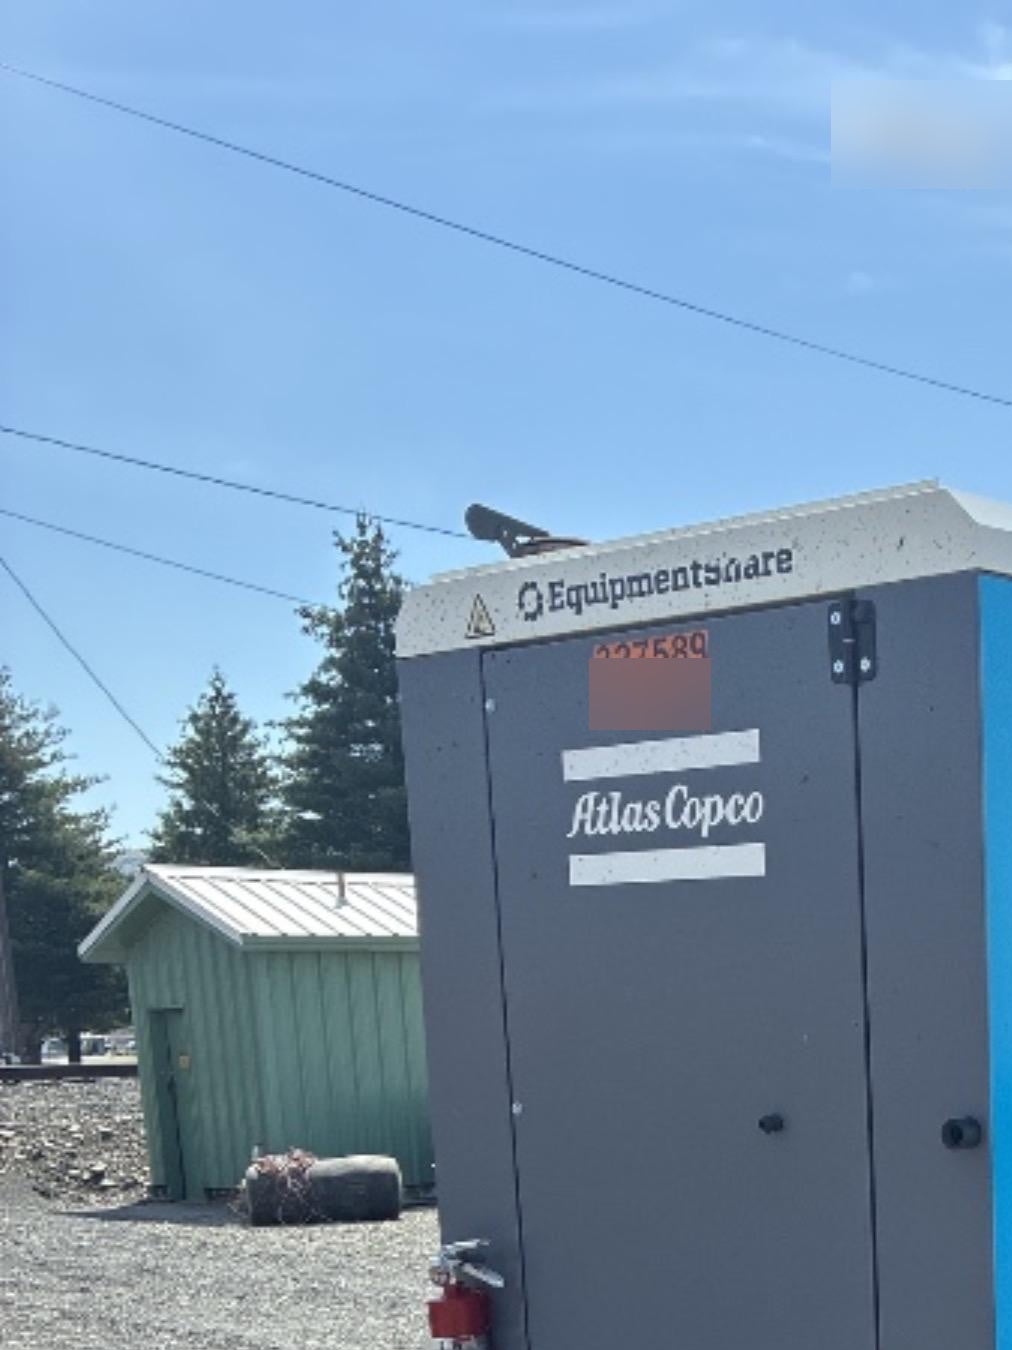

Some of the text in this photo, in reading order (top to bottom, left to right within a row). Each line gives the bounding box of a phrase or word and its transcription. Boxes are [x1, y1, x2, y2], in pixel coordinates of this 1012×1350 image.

[548, 547, 794, 616] EquipmentShare
[566, 784, 764, 838] Atlas Copco
